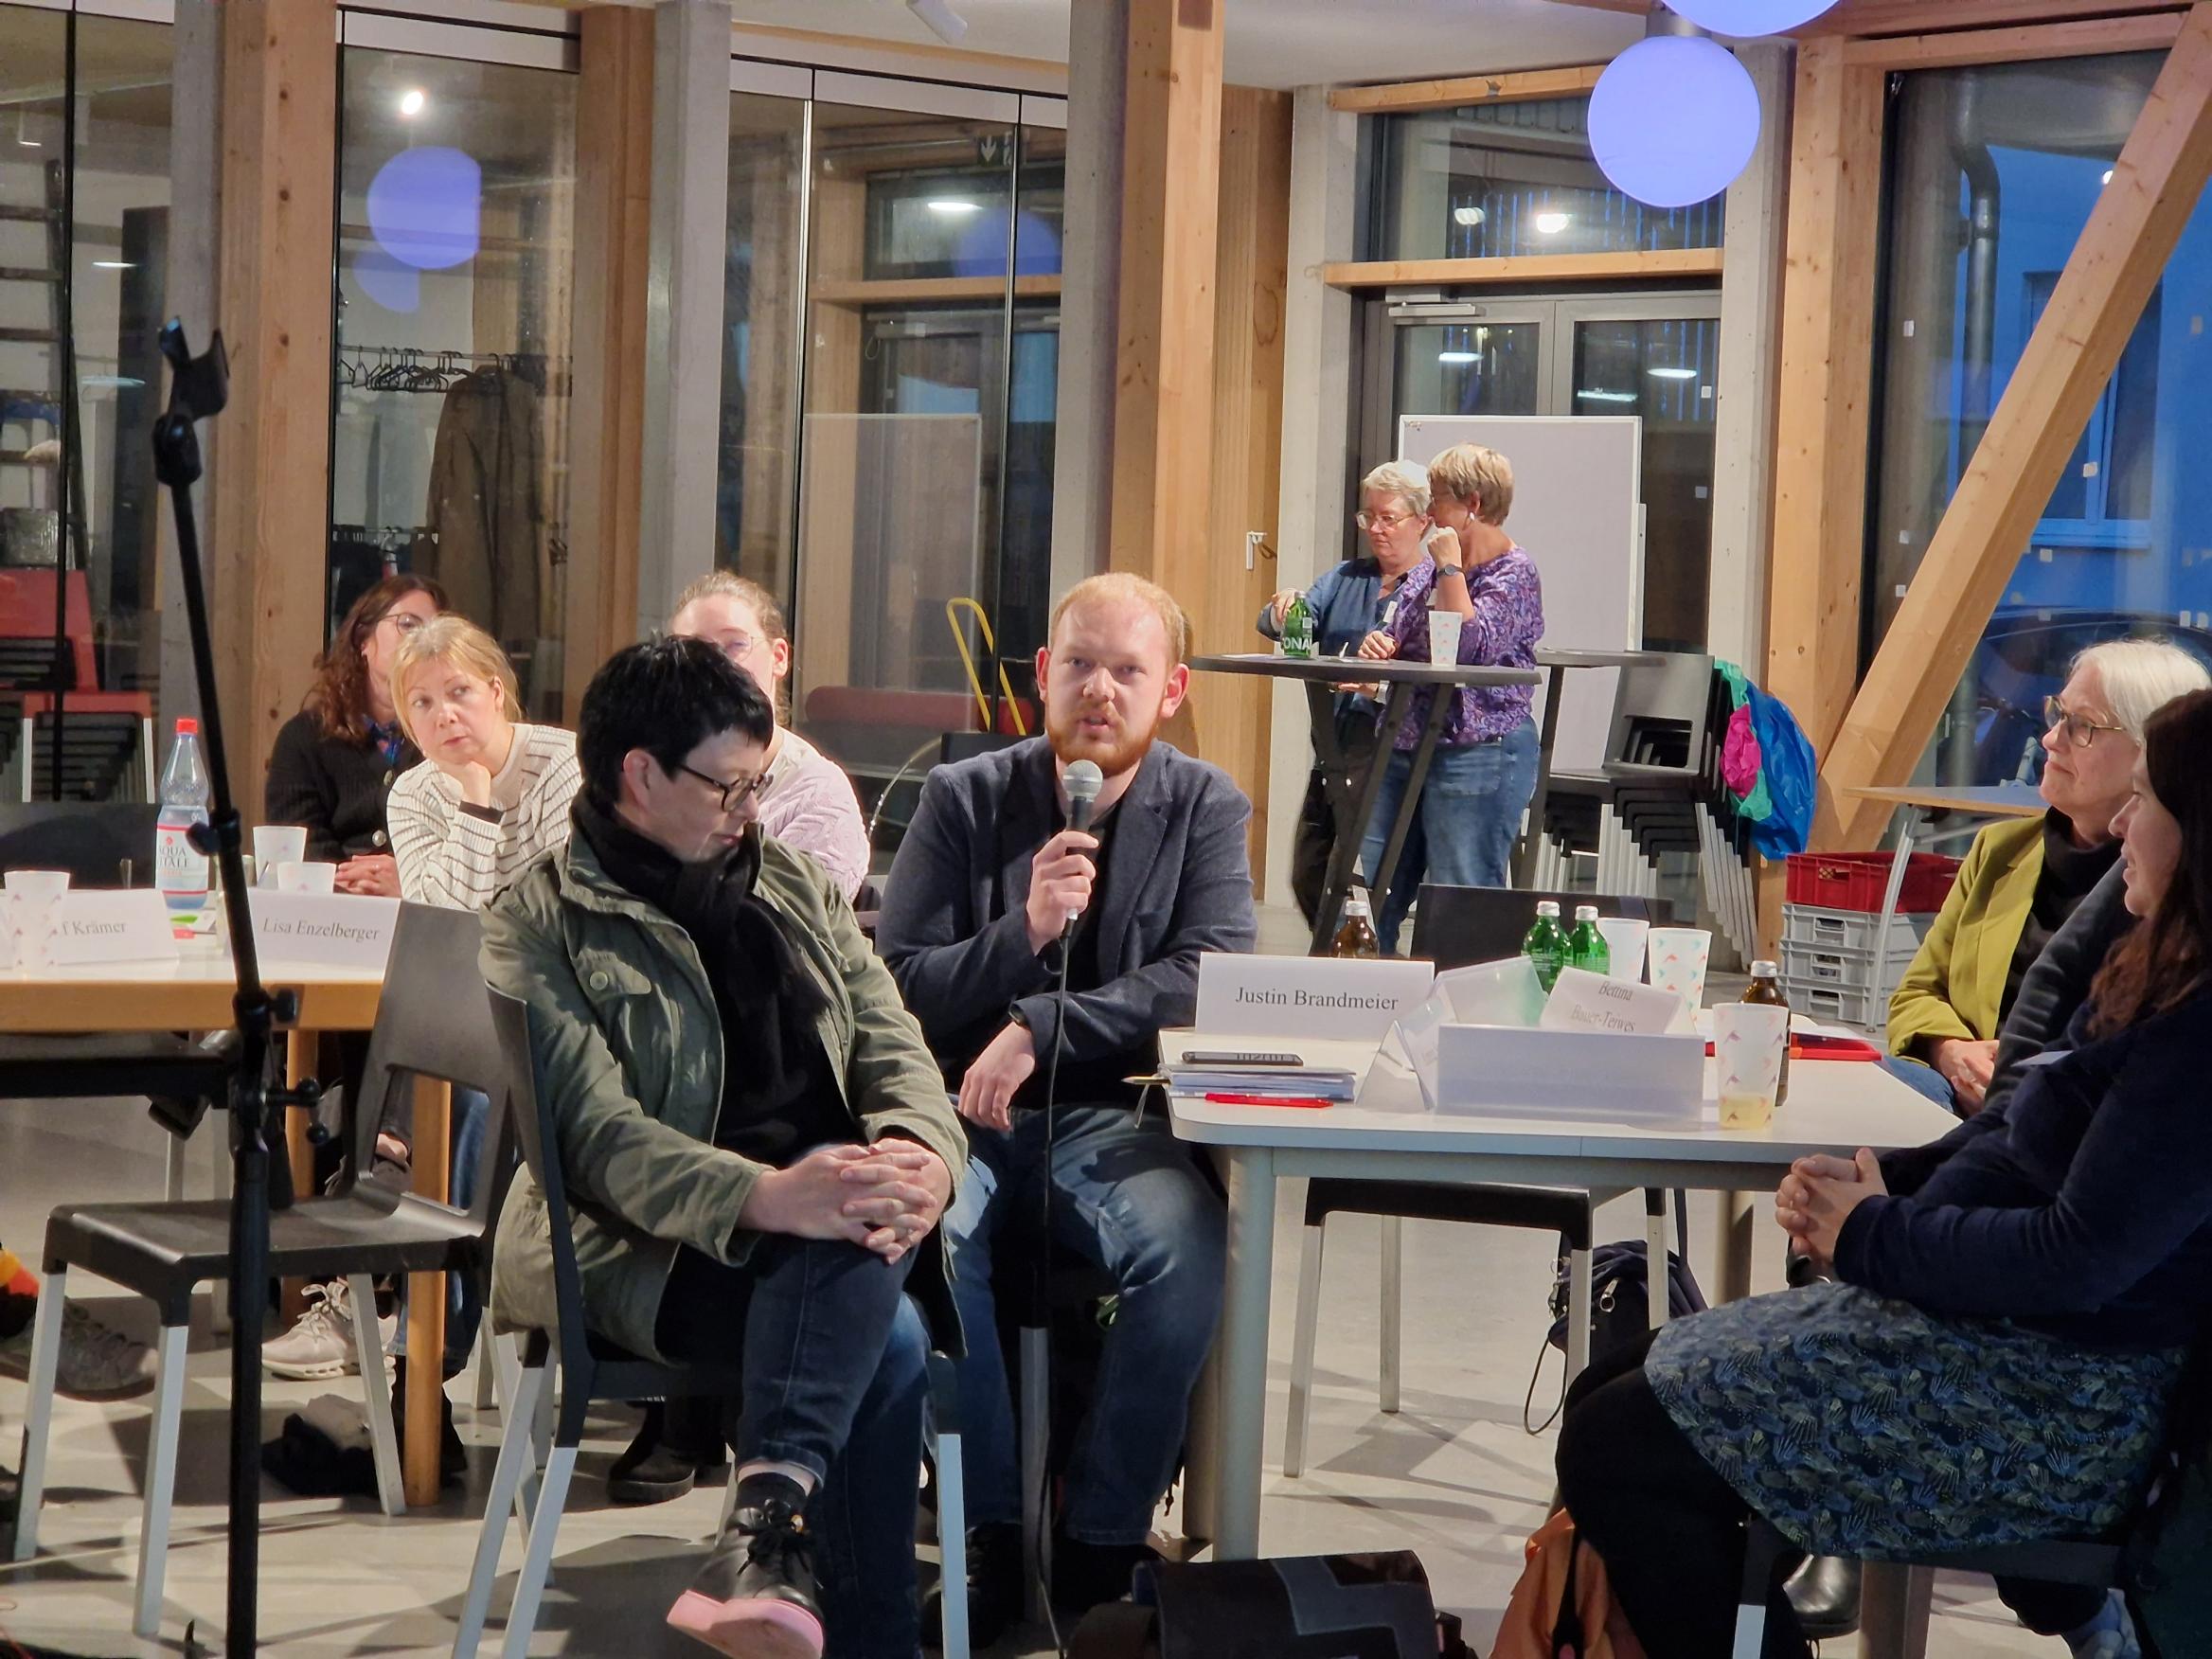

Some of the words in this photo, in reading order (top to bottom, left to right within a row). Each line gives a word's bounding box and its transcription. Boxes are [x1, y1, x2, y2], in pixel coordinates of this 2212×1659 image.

[263, 917, 293, 934] Lisa
[295, 919, 380, 943] Enzelberger
[1235, 986, 1287, 1006] Justin
[1293, 990, 1399, 1010] Brandmeier
[1597, 980, 1633, 1001] Bettina
